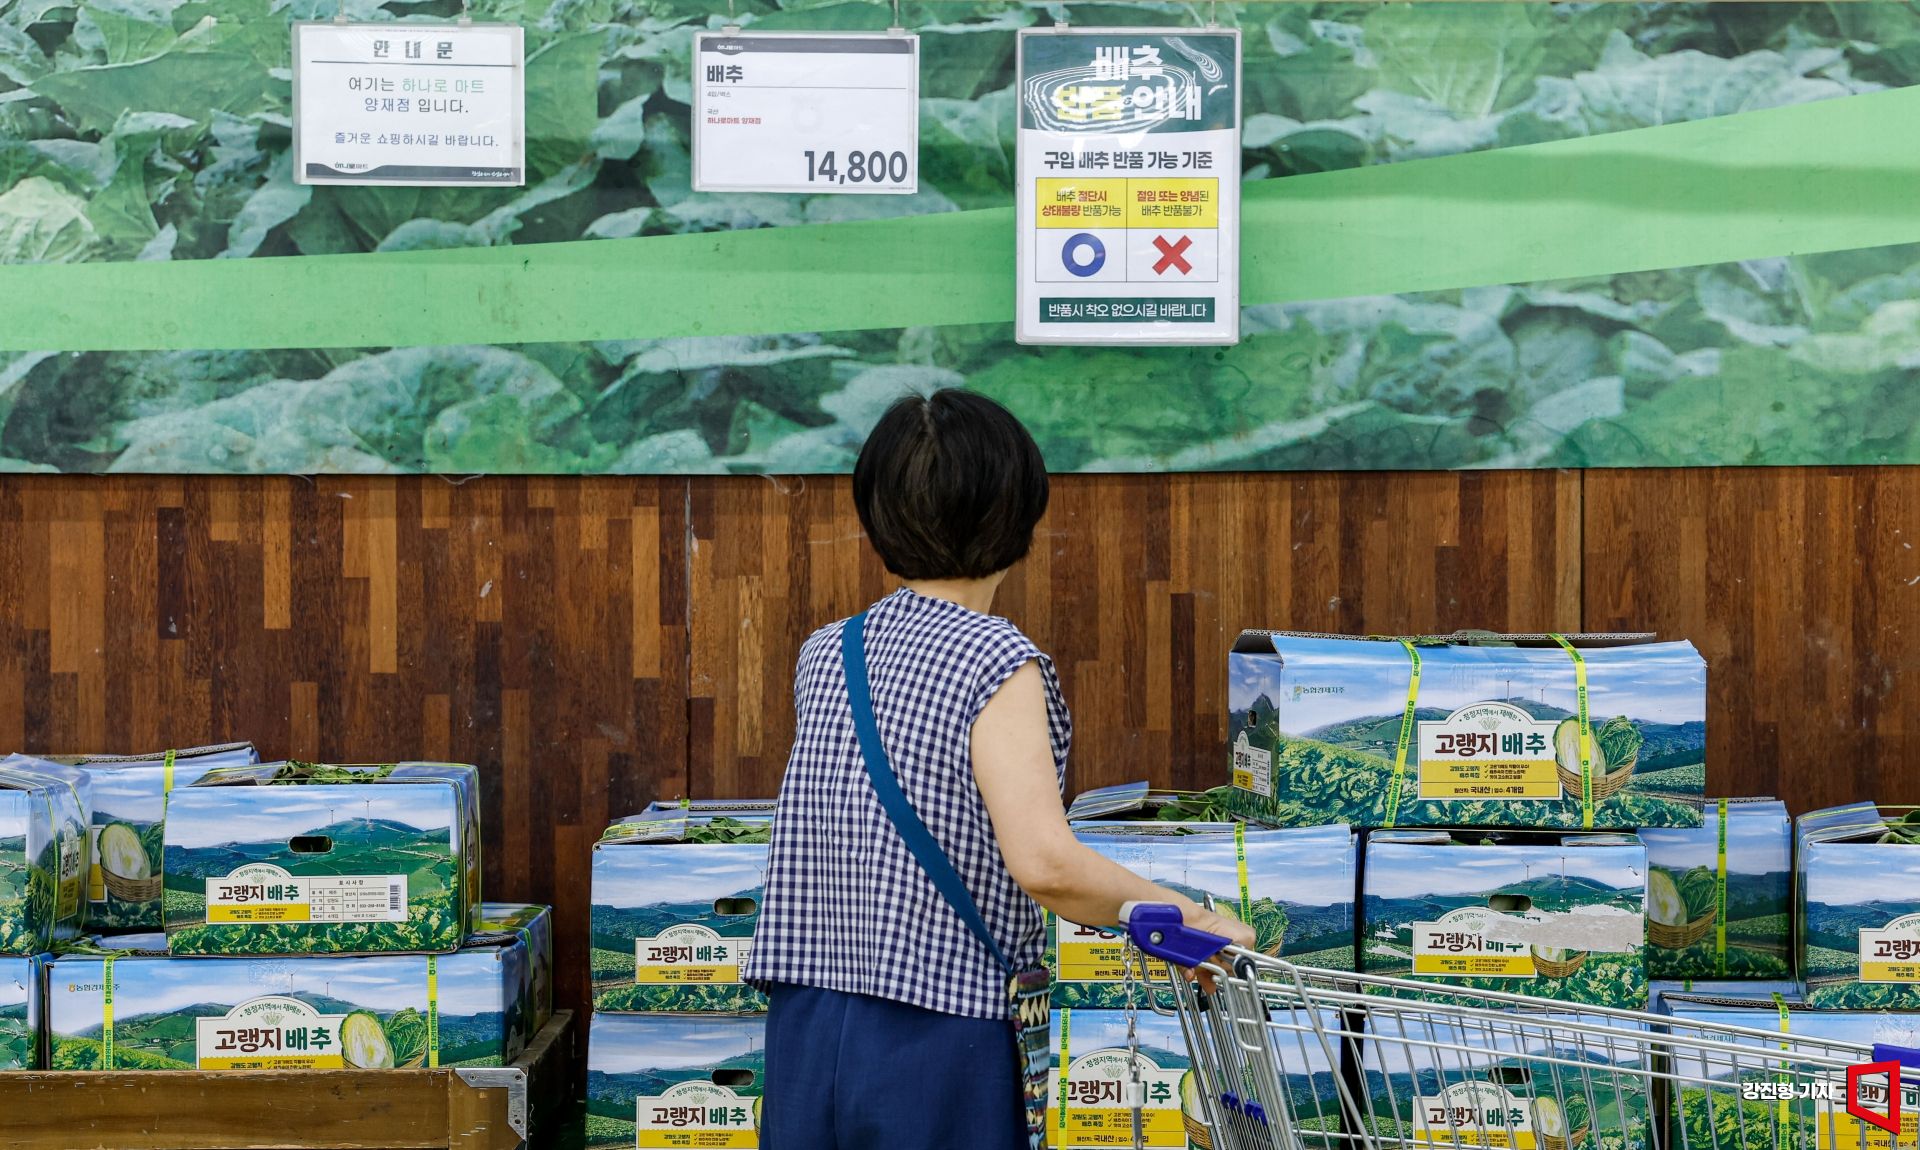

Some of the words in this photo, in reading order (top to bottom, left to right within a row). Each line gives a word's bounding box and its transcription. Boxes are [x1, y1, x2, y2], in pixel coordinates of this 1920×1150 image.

[1095, 44, 1163, 80] 배추
[707, 65, 744, 83] 배추
[349, 76, 394, 93] 여기는
[402, 78, 448, 94] 하나로
[456, 79, 484, 94] 마트
[364, 98, 410, 112] 양재점
[418, 98, 470, 113] 입니다.
[1132, 85, 1202, 120] 안내
[335, 132, 371, 144] 즐거운
[377, 134, 438, 146] 쇼핑하시길
[445, 134, 499, 147] 바랍니다.
[804, 150, 908, 184] 14,800
[1044, 151, 1074, 169] 구입
[1078, 151, 1110, 169] 배추
[1113, 151, 1144, 169] 반품
[1148, 151, 1178, 169] 가능
[1182, 151, 1212, 169] 기준
[1056, 190, 1076, 201] 배추
[1078, 190, 1107, 201] 절단시
[1136, 190, 1156, 201] 절임
[1158, 190, 1178, 201] 또는
[1180, 190, 1209, 201] 양념된
[1042, 204, 1081, 216] 상태불량
[1082, 204, 1121, 216] 반품가능
[1142, 205, 1161, 216] 배추
[1164, 205, 1202, 216] 반품불가
[1048, 304, 1083, 318] 반품시
[1085, 304, 1109, 318] 착오
[1112, 304, 1157, 318] 없으시길
[1160, 304, 1206, 318] 바랍니다
[1434, 732, 1498, 756] 고랭지
[1502, 732, 1546, 755] 배추
[218, 885, 264, 902] 고랭지
[268, 884, 299, 900] 배추
[647, 946, 692, 963] 고랭지
[696, 946, 728, 961] 배추
[244, 1003, 281, 1015] 청정지역에서
[215, 1028, 280, 1052] 고랭지
[285, 1027, 332, 1050] 배추
[1086, 1056, 1123, 1068] 청정지역에서
[651, 1106, 706, 1126] 고랭지
[710, 1106, 747, 1126] 배추
[1487, 1108, 1524, 1127] 배추
